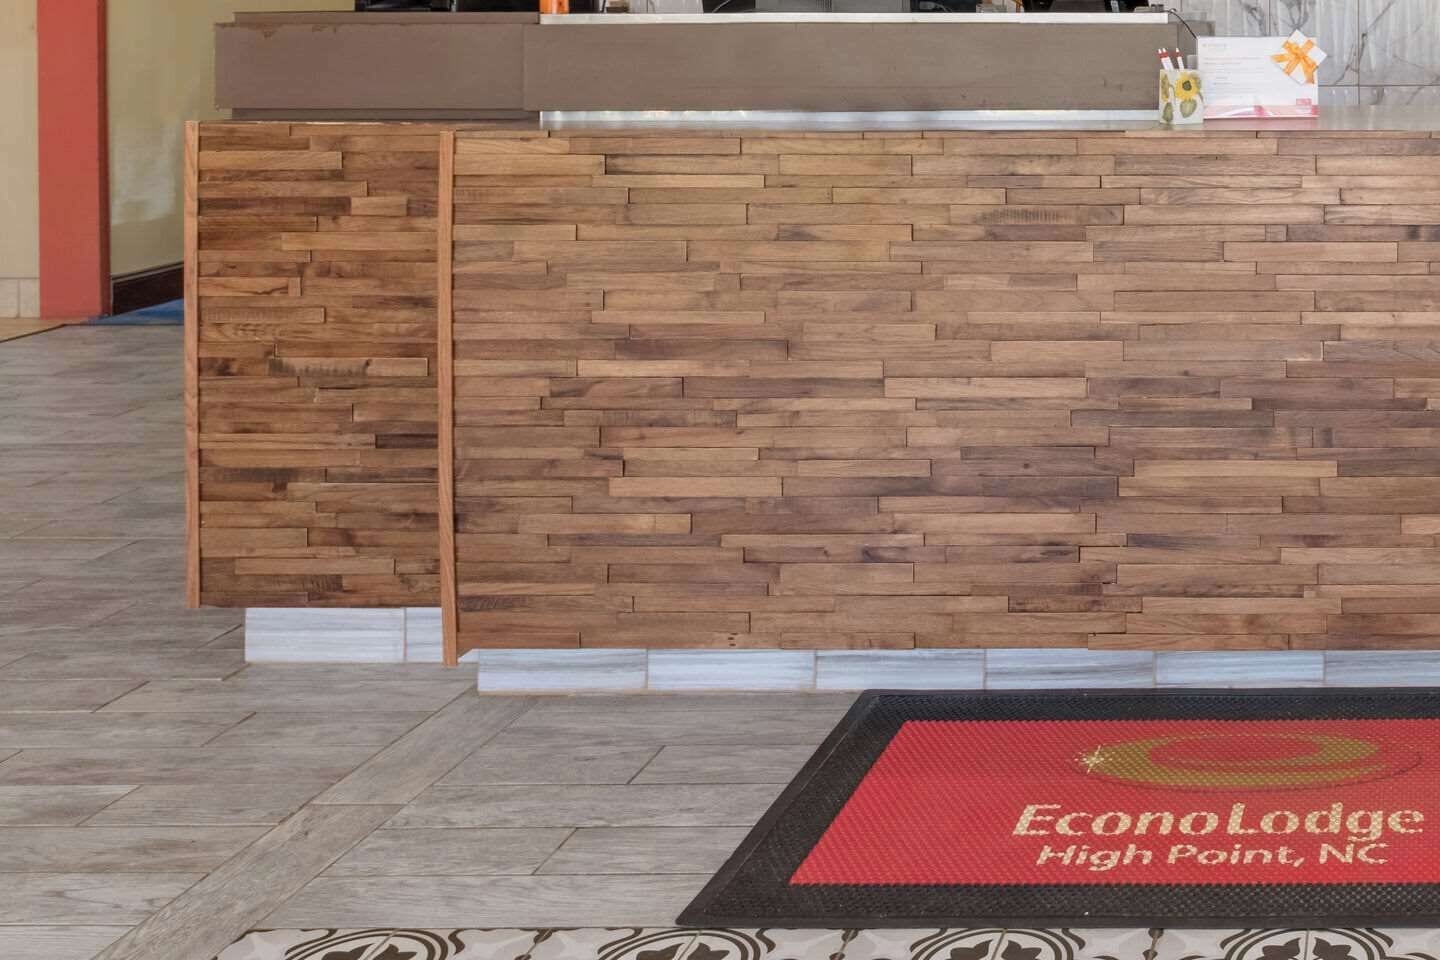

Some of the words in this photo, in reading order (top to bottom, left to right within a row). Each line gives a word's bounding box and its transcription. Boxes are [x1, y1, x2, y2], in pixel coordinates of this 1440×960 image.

[1036, 843, 1153, 872] High
[1166, 843, 1305, 869] Point,
[1318, 842, 1390, 865] NC
